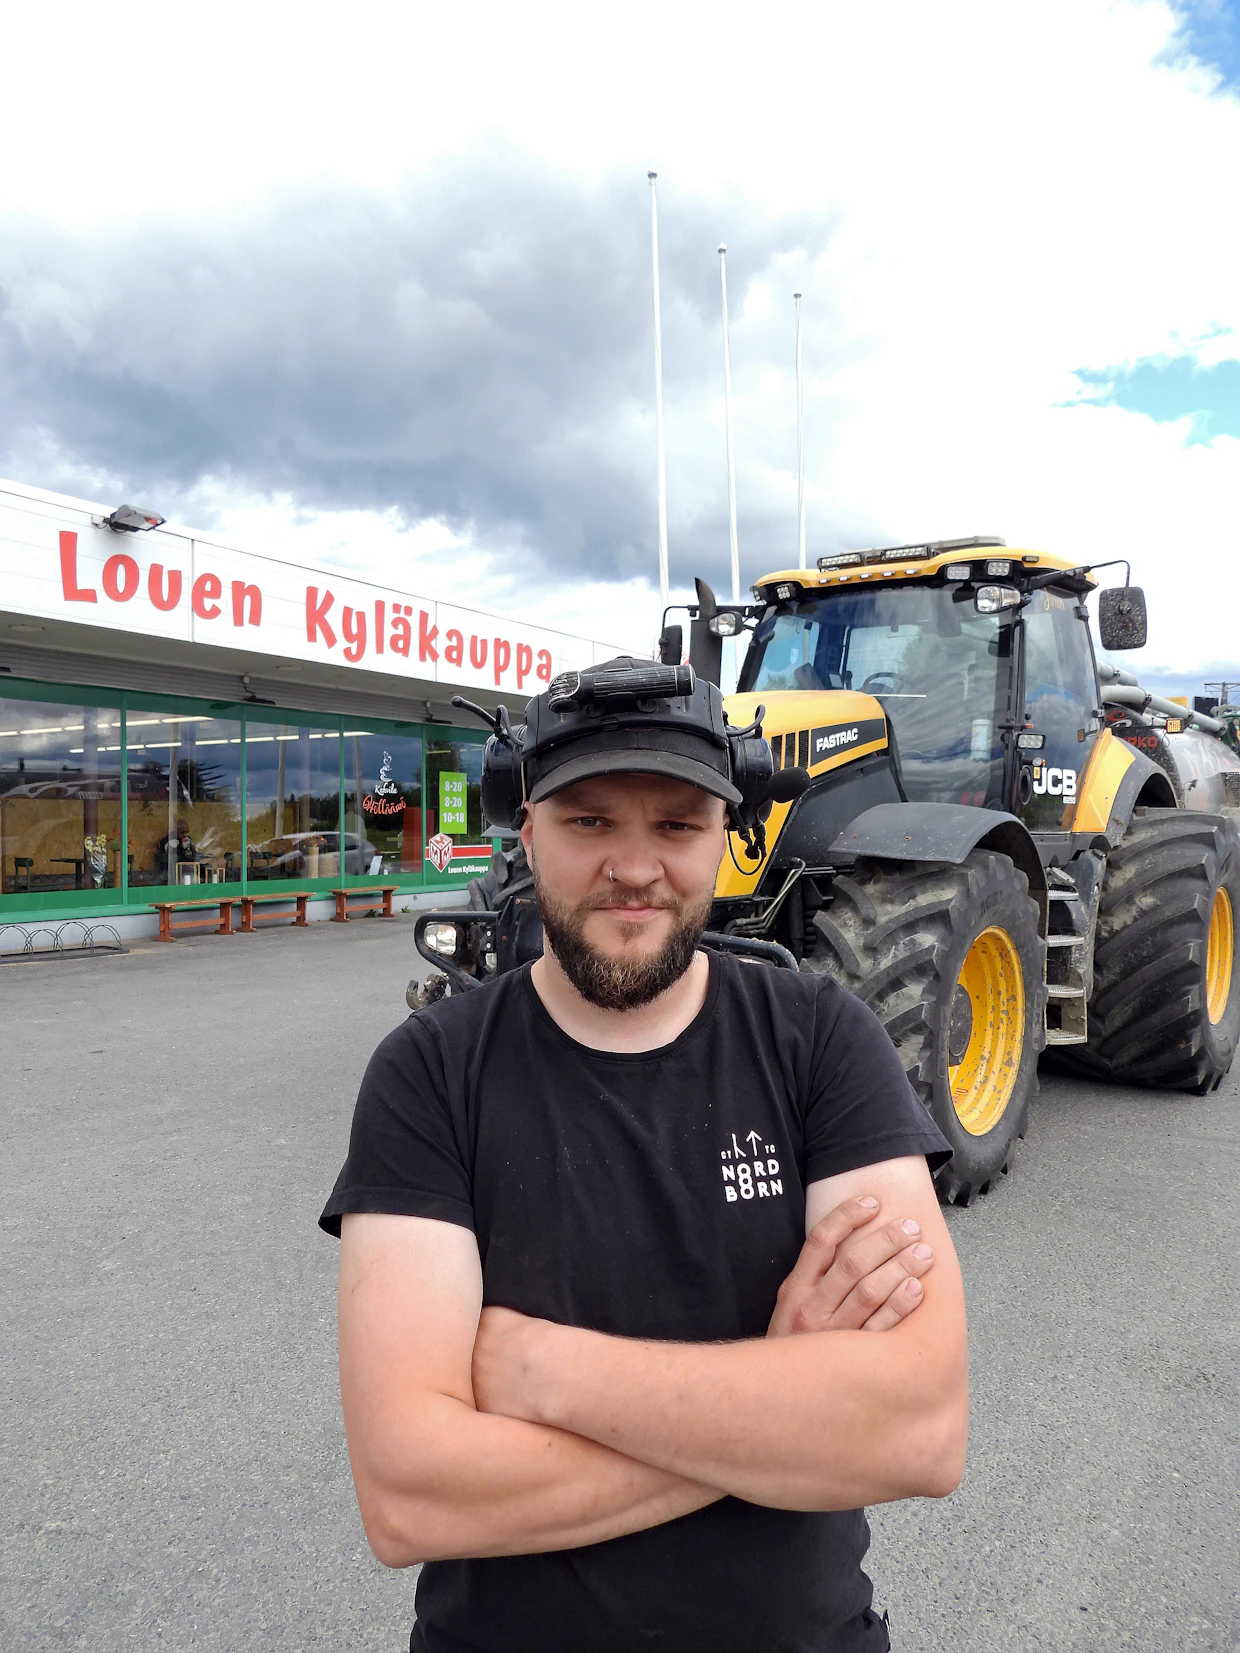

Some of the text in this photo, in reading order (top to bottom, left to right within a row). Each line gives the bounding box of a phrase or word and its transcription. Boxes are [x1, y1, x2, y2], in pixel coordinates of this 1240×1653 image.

[59, 531, 552, 690] Louen Kyläkauppa
[816, 727, 858, 752] FASTRAC
[1033, 767, 1076, 796] JCB
[442, 812, 465, 823] 10-18
[447, 866, 462, 874] Louen
